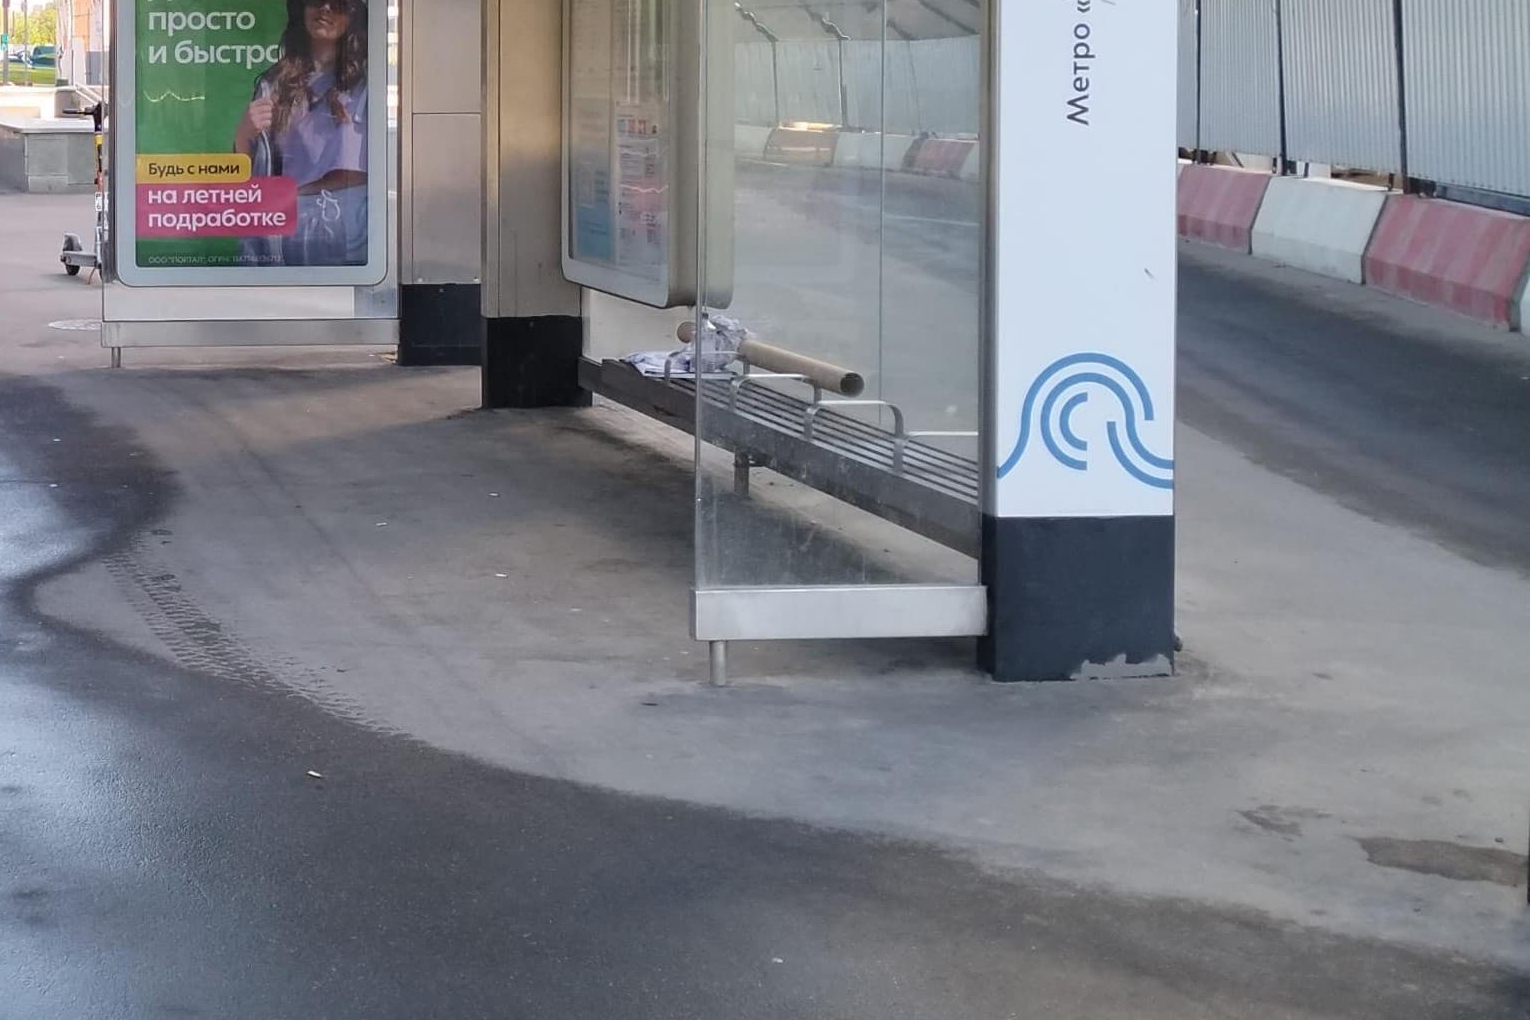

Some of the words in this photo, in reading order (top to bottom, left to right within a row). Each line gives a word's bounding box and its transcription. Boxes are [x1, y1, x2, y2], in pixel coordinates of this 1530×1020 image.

[148, 11, 256, 37] просто
[148, 45, 167, 64] и
[174, 40, 285, 70] быстро
[1066, 23, 1096, 126] Метро
[148, 162, 184, 178] Будь
[187, 164, 196, 175] с
[198, 164, 240, 175] нами
[148, 189, 177, 204] на
[182, 184, 262, 204] летней
[148, 209, 287, 232] подработке
